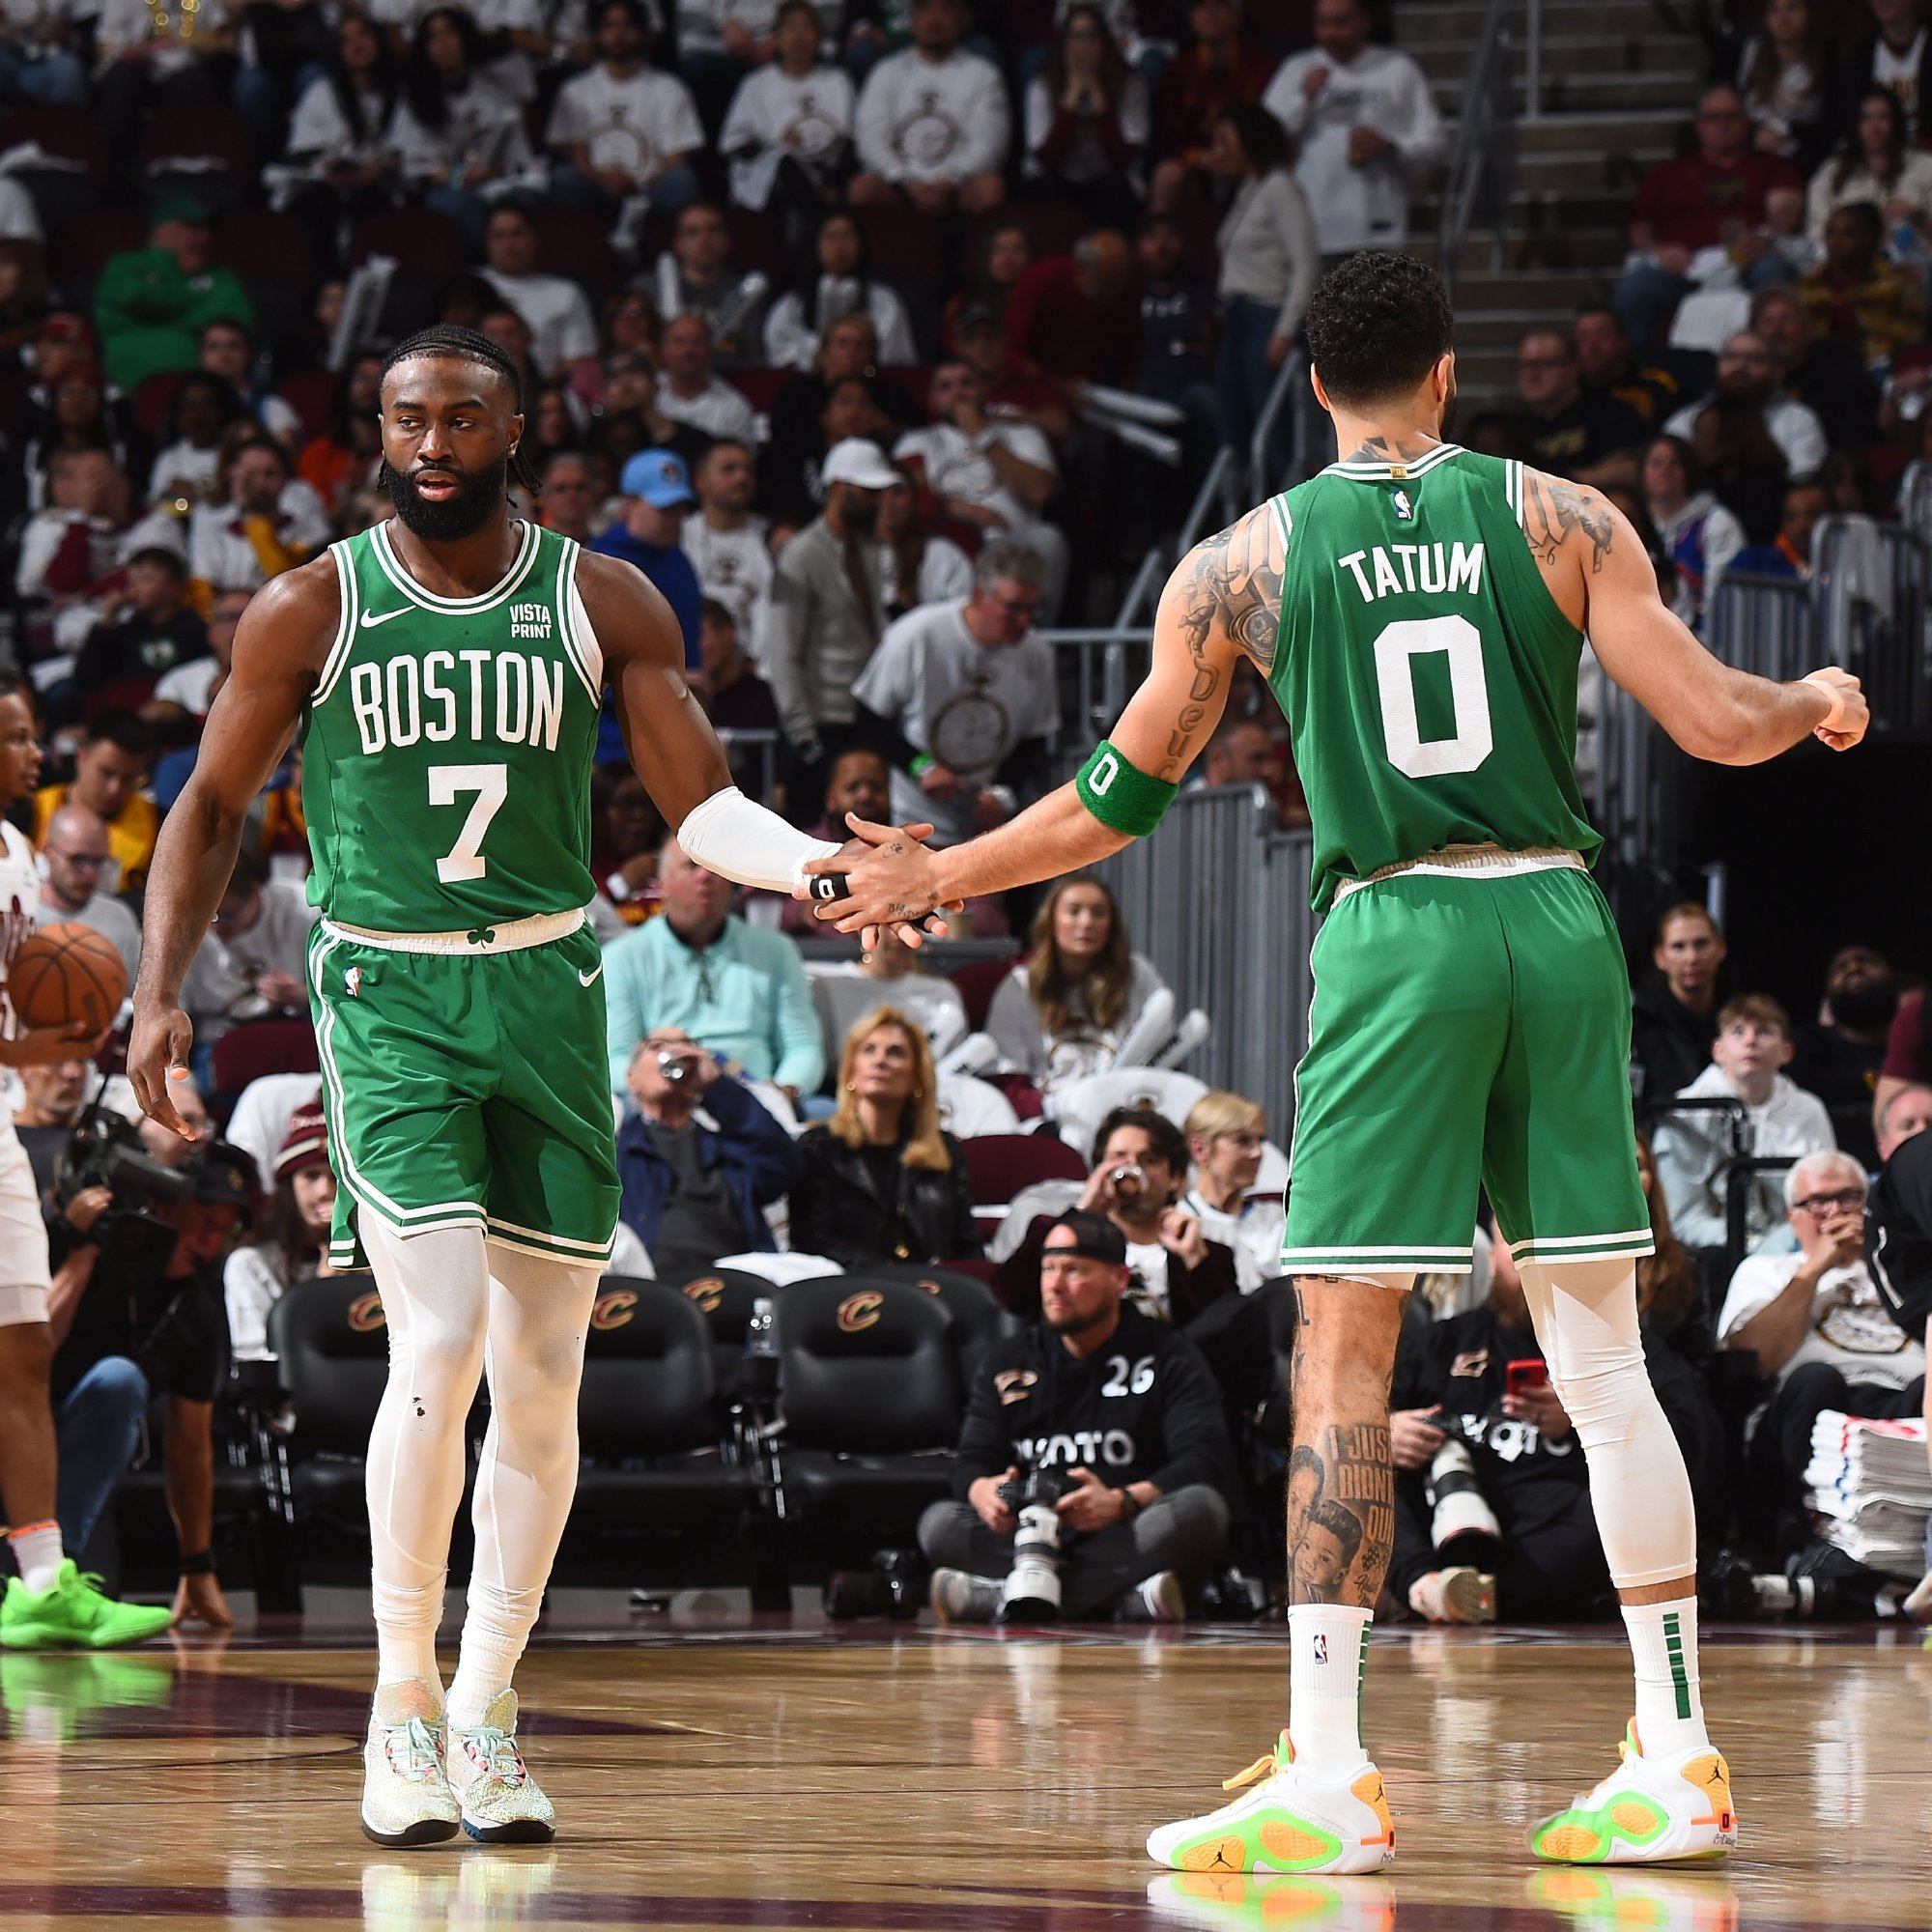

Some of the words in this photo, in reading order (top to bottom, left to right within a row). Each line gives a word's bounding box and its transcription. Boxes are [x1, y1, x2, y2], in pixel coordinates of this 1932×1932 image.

[1337, 541, 1484, 604] TATUM
[509, 603, 552, 625] VISTA
[511, 624, 552, 639] PRINT
[350, 649, 564, 755] BOSTON
[1373, 613, 1493, 779] 0
[1089, 753, 1119, 796] 0
[428, 763, 508, 884] 7
[1101, 1354, 1156, 1397] 26
